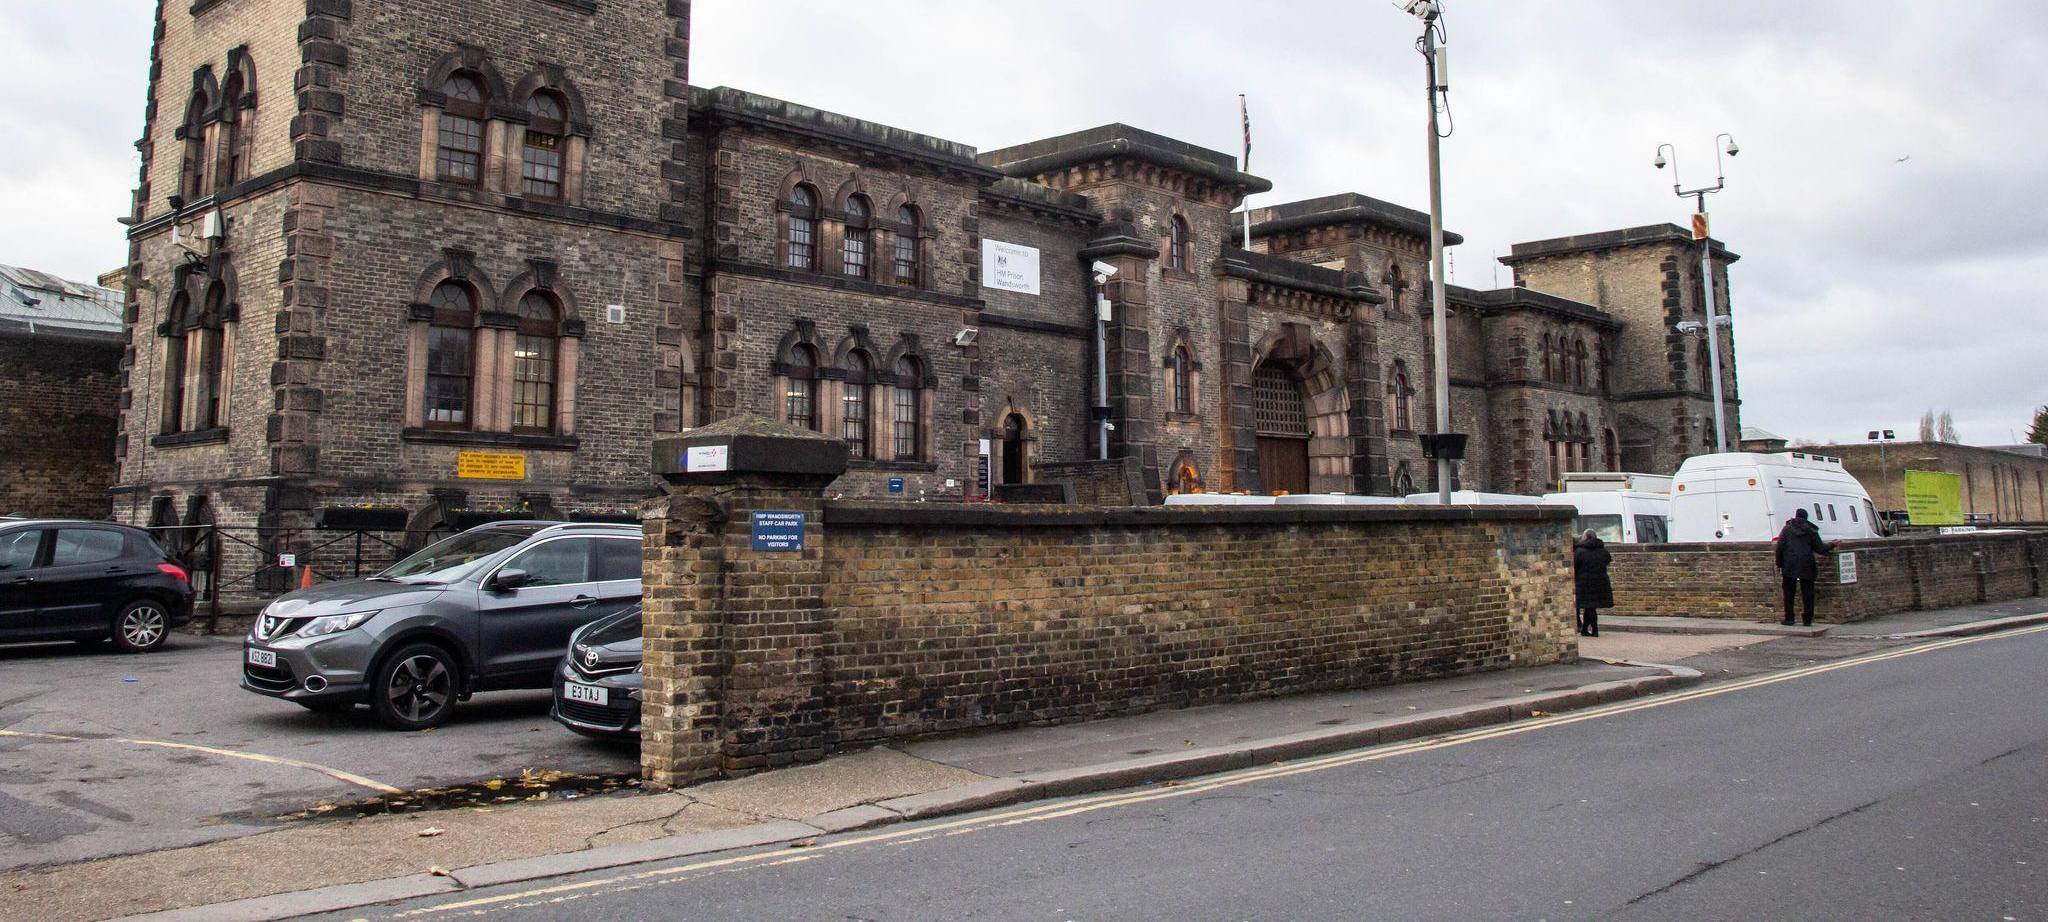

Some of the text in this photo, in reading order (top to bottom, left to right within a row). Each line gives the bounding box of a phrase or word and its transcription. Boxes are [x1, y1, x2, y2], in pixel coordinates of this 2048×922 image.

[994, 243, 1021, 255] Welcome
[997, 269, 1024, 281] HM Prison
[996, 279, 1030, 290] Wandsworth
[572, 685, 599, 701] E3 TAJ
